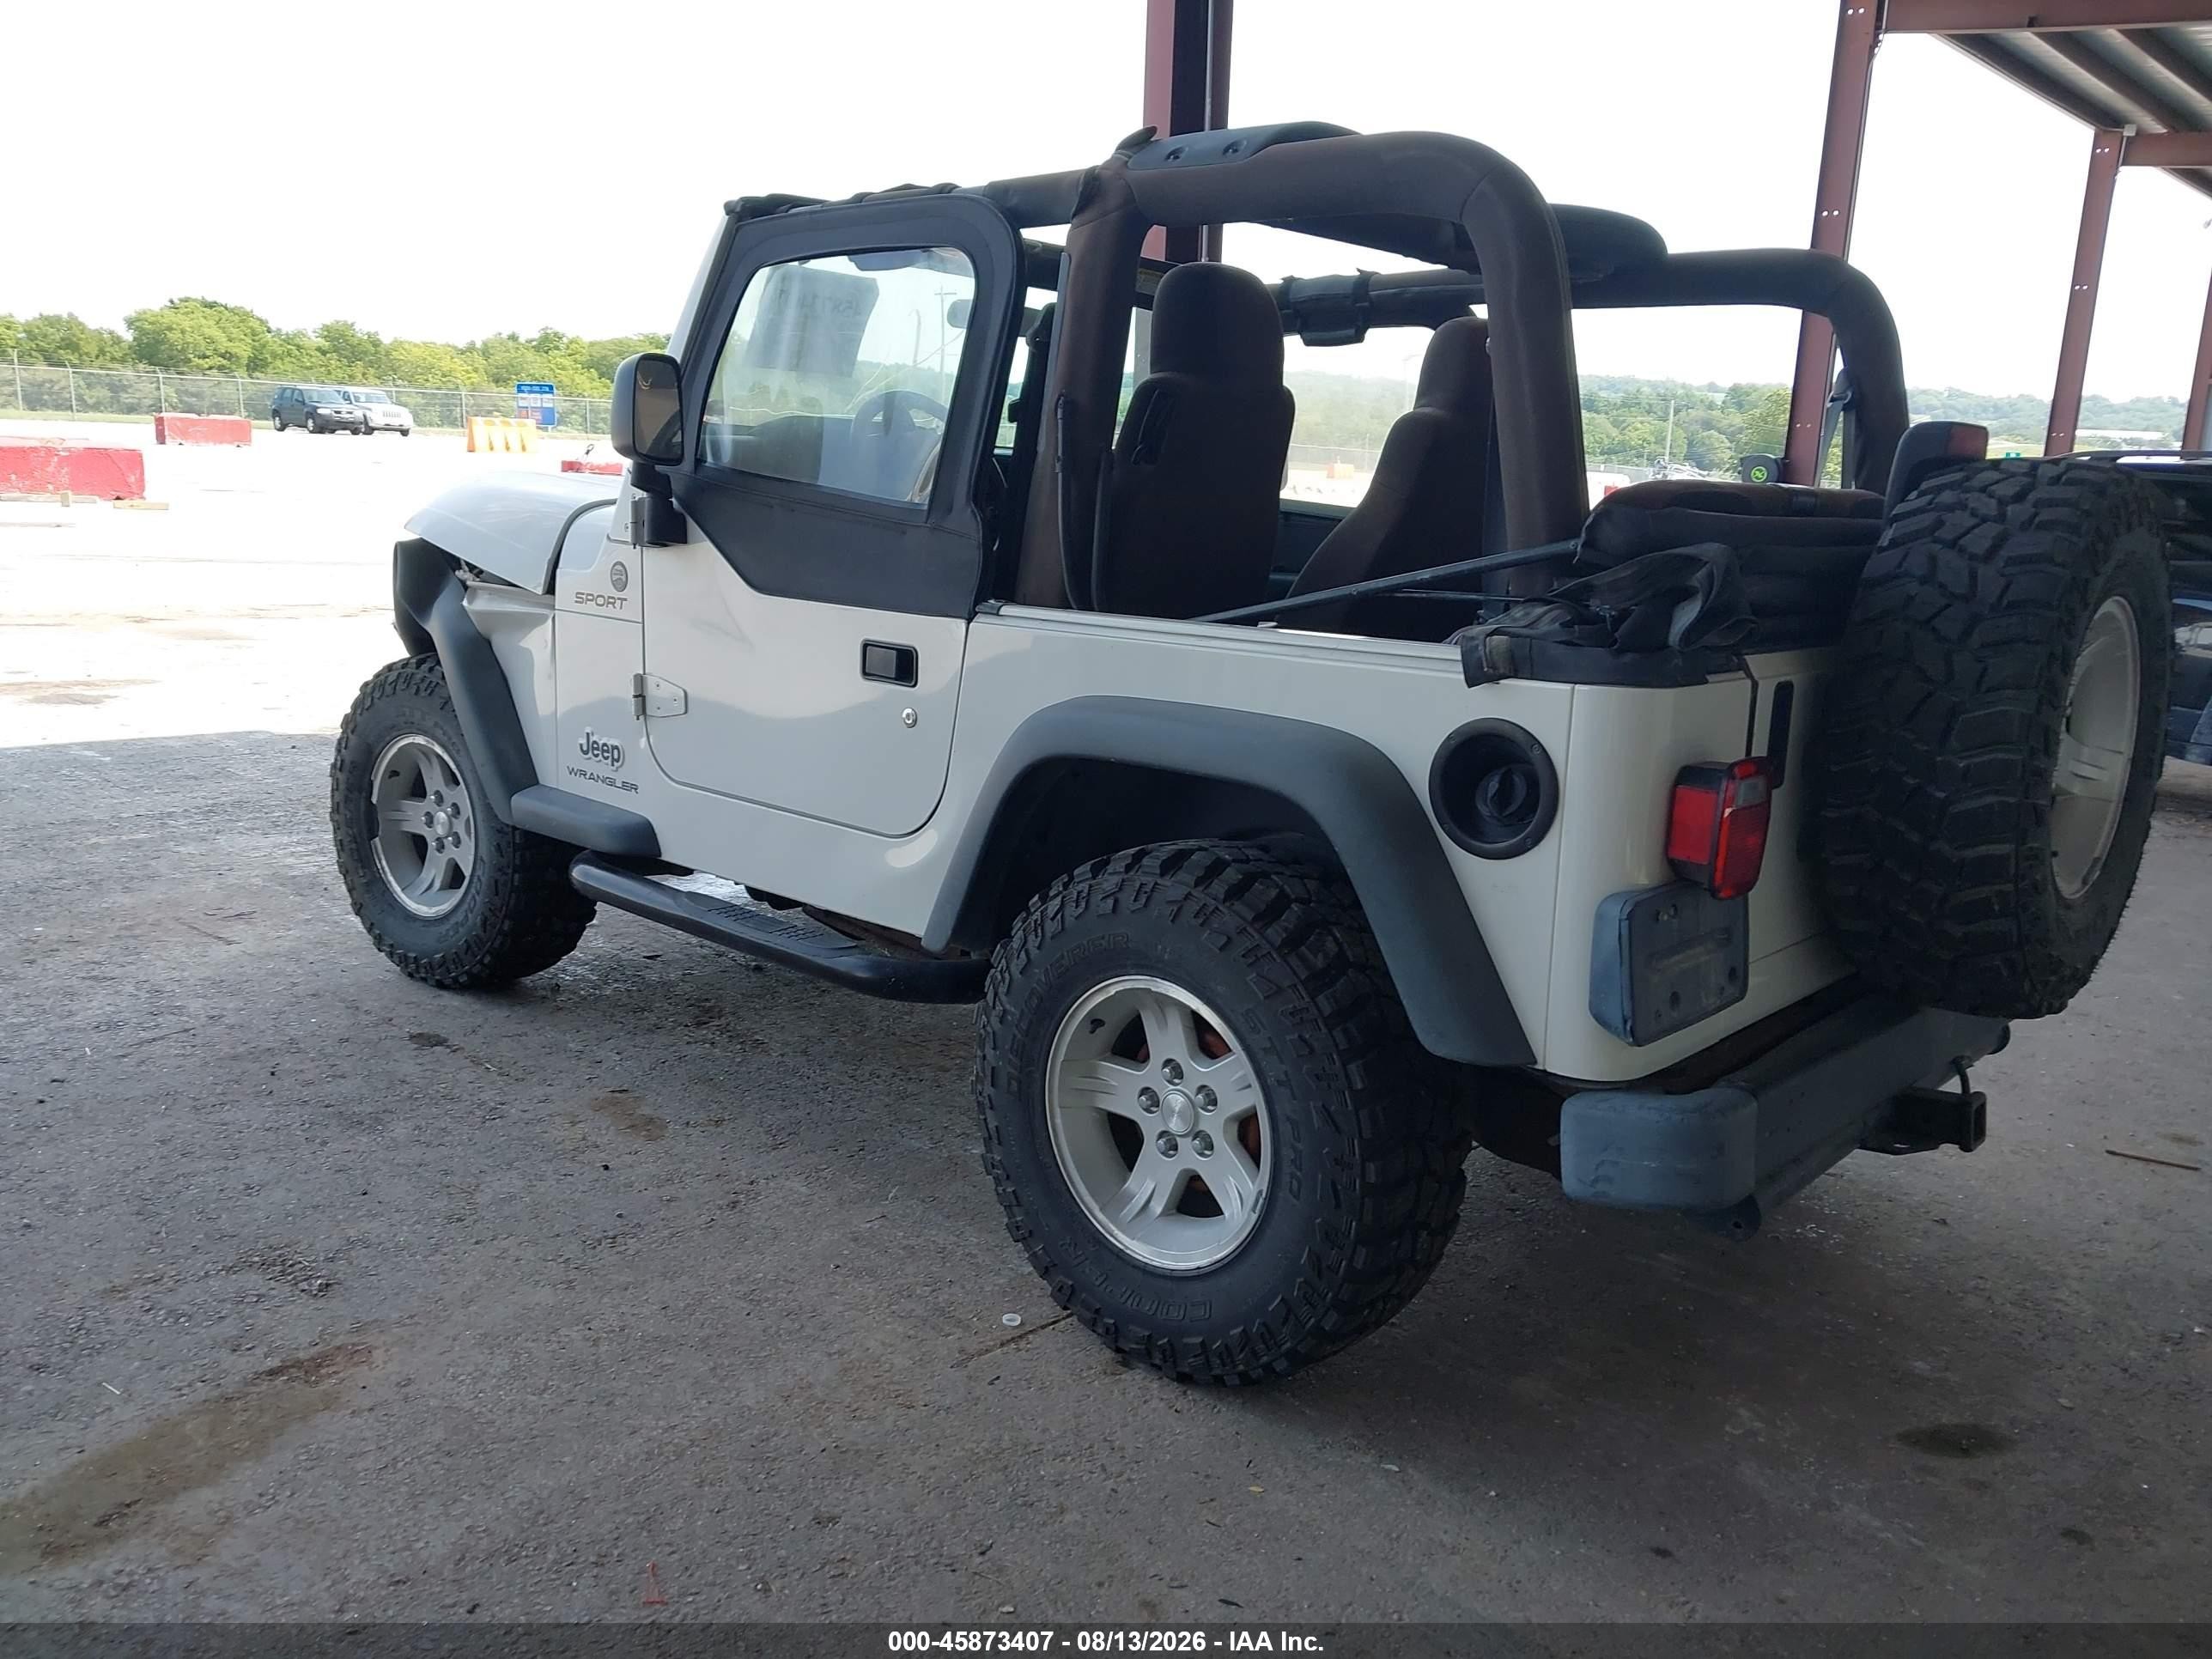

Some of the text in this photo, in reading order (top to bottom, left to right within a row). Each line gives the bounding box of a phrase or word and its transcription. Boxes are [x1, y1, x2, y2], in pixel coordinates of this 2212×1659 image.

[574, 592, 628, 610] SPORT
[579, 731, 621, 767] Jeep
[567, 765, 639, 794] WRANGLER
